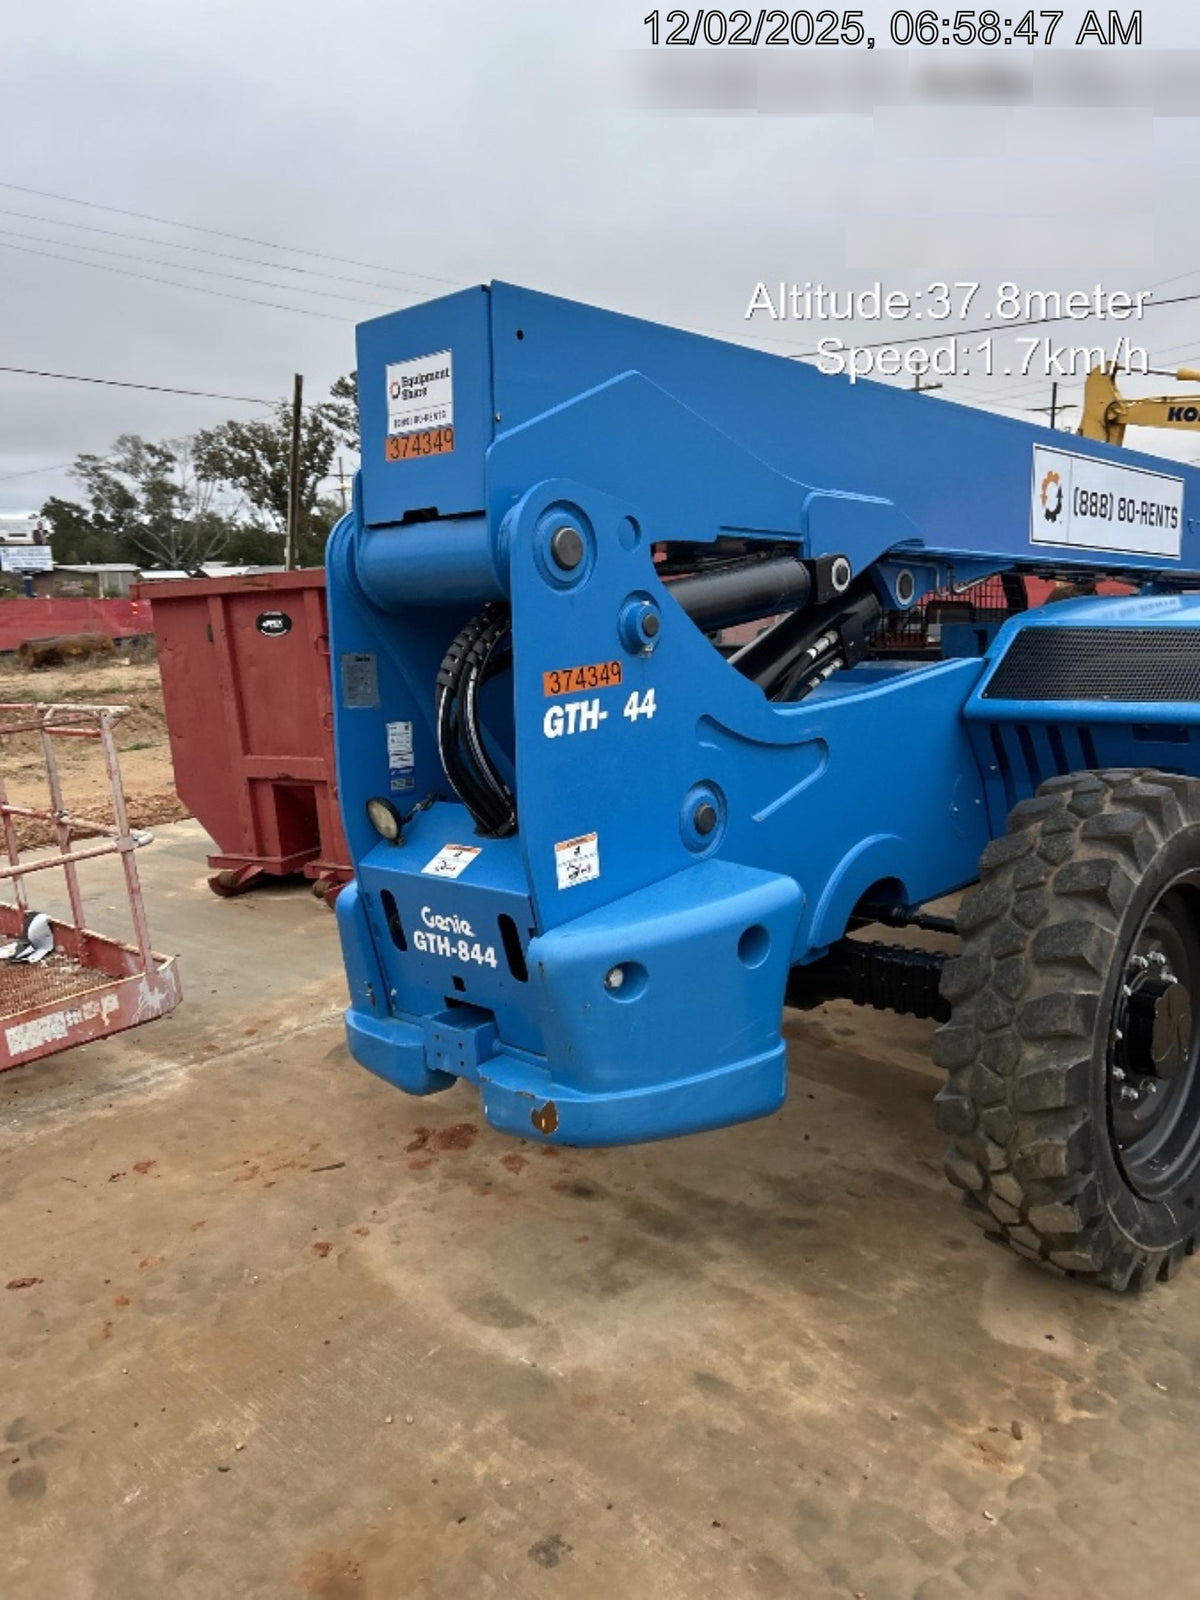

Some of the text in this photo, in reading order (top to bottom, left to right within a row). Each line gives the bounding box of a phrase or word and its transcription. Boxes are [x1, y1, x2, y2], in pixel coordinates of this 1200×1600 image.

[401, 367, 450, 388] Equipment
[1167, 406, 1200, 422] KO
[390, 428, 454, 460] 374349
[1073, 487, 1178, 530] (888) 80-RENTS
[548, 661, 621, 695] 374349
[543, 688, 657, 739] GTH- 44
[420, 905, 476, 938] Genie
[413, 930, 498, 968] GTH-844
